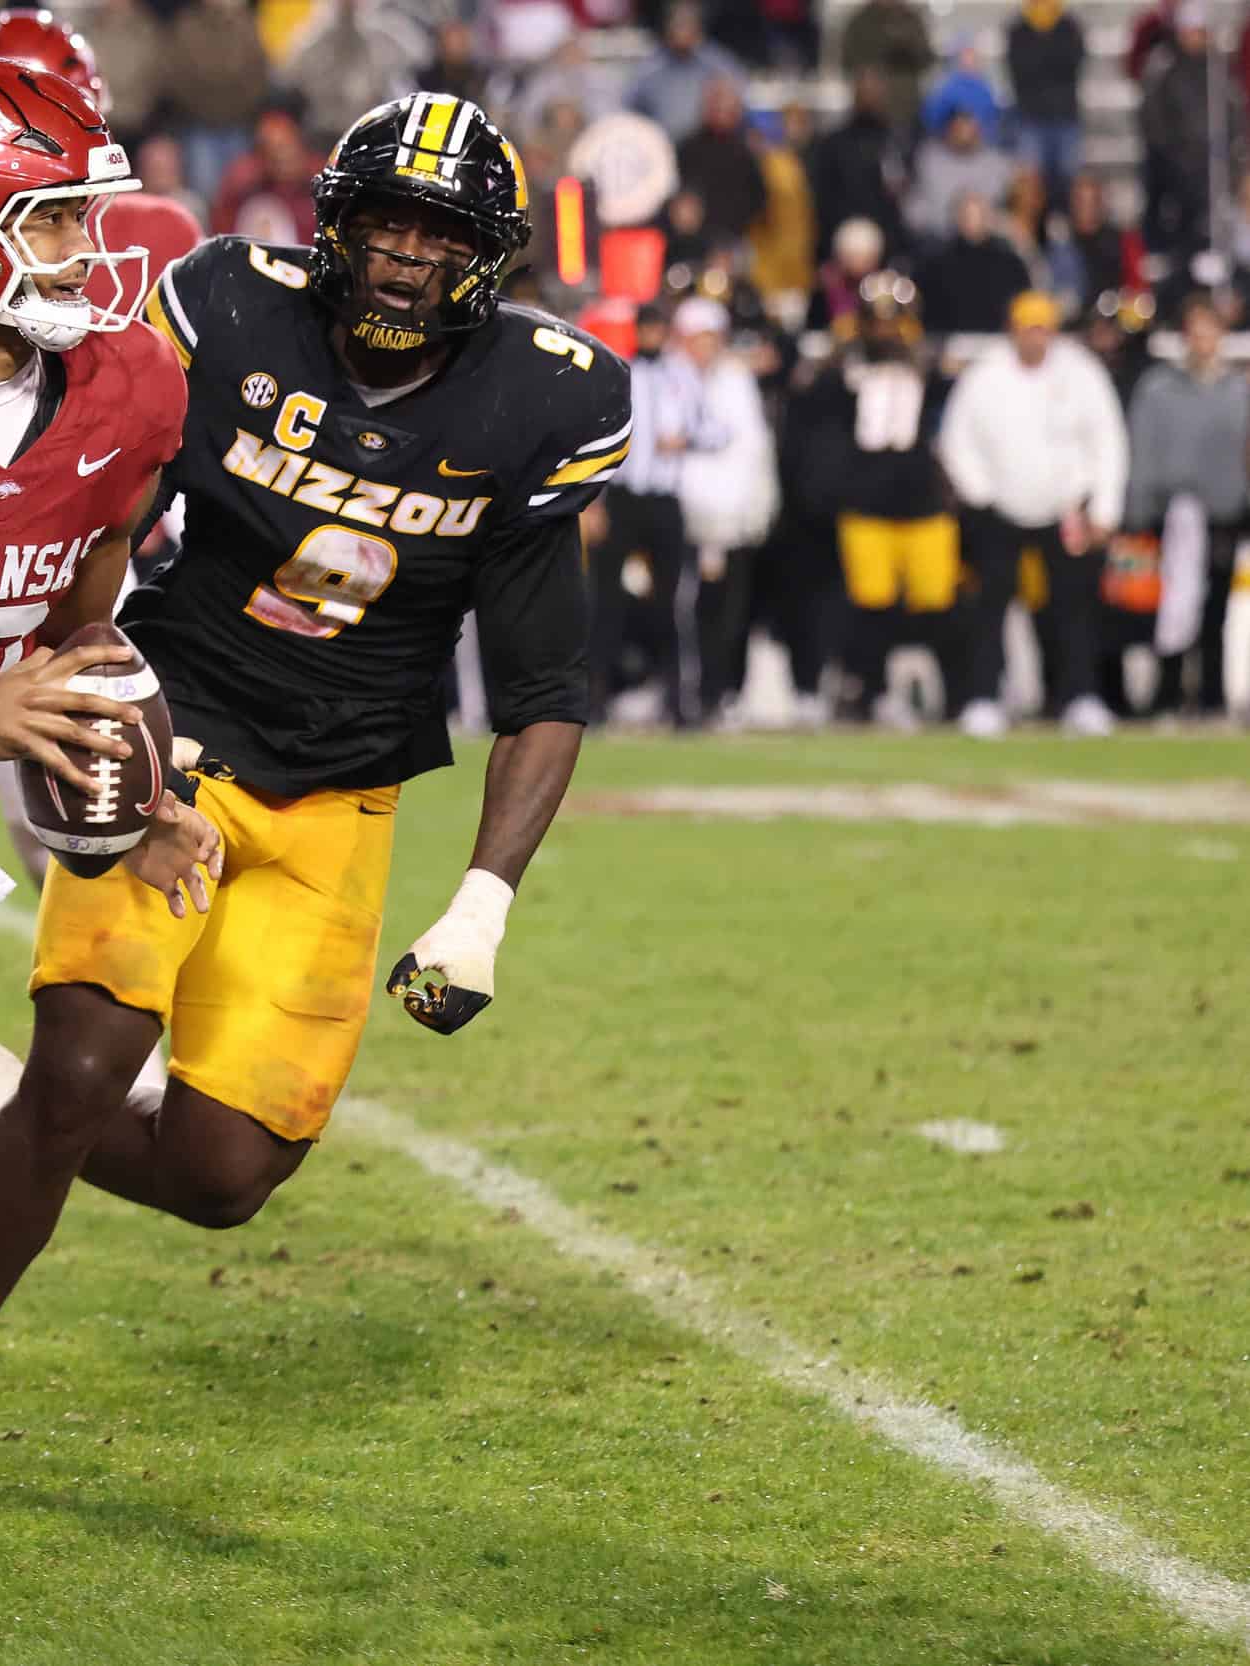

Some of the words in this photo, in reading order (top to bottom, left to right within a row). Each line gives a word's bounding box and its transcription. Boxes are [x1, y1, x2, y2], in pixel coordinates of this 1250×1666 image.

[244, 375, 275, 407] SEC
[273, 391, 328, 452] C
[222, 426, 493, 537] MIZZOU
[243, 523, 398, 640] 9
